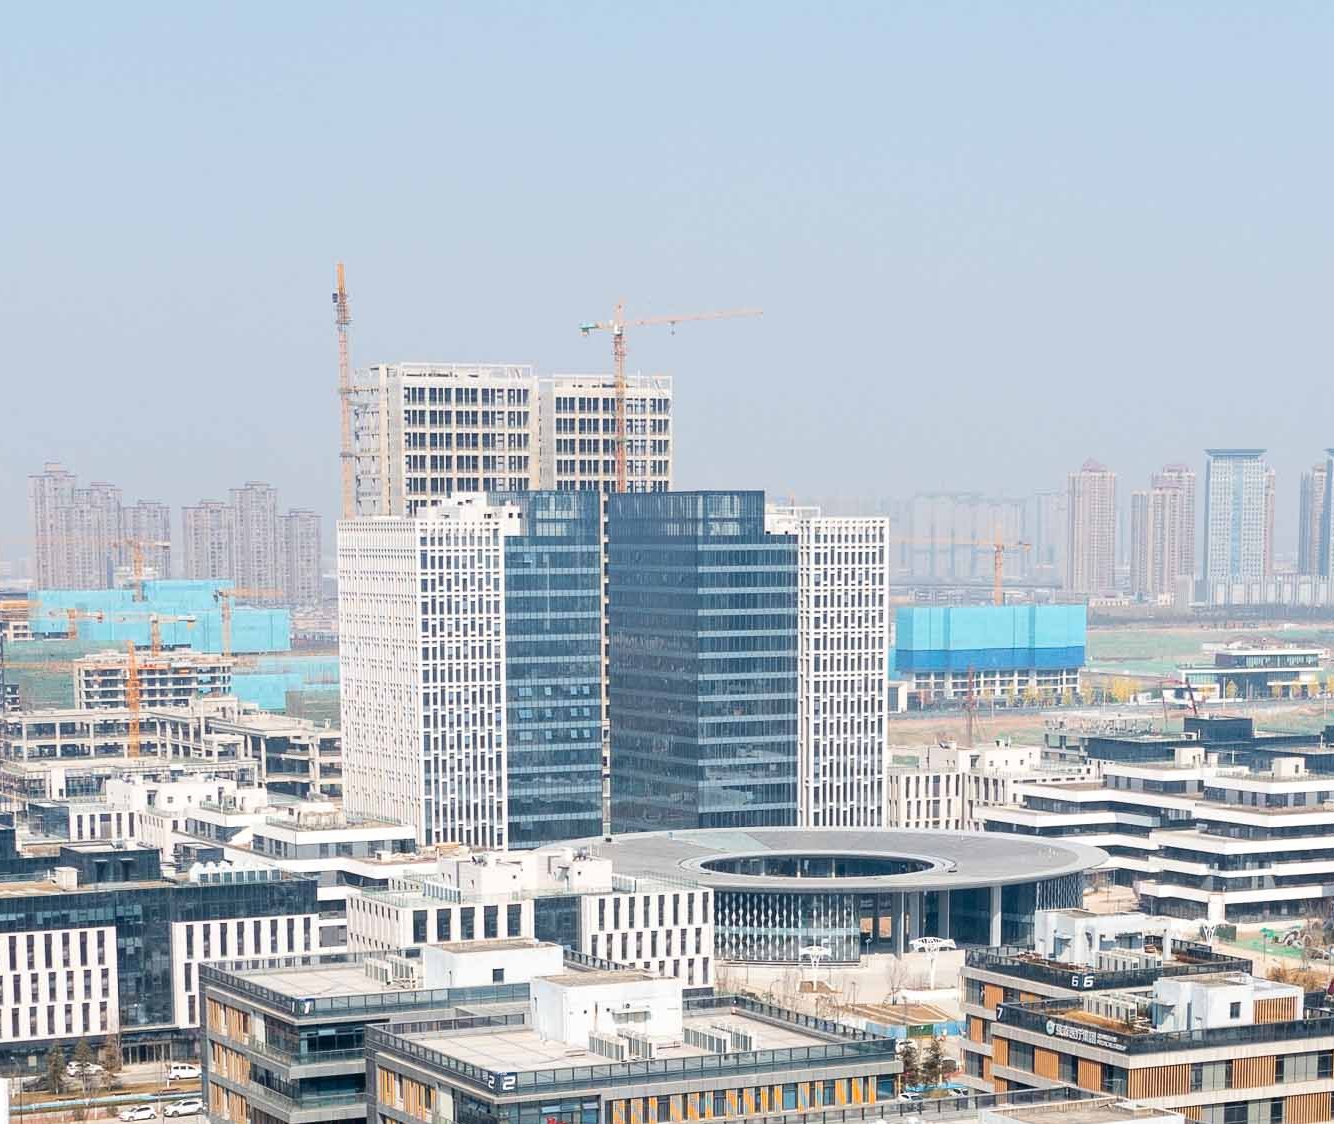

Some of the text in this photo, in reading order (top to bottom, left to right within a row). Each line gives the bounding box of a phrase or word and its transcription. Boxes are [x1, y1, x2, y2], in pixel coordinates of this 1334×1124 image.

[1071, 975, 1079, 987] 6
[1083, 975, 1094, 988] 6
[996, 1007, 1003, 1019] 7
[488, 1075, 495, 1089] 2
[503, 1076, 516, 1090] 2
